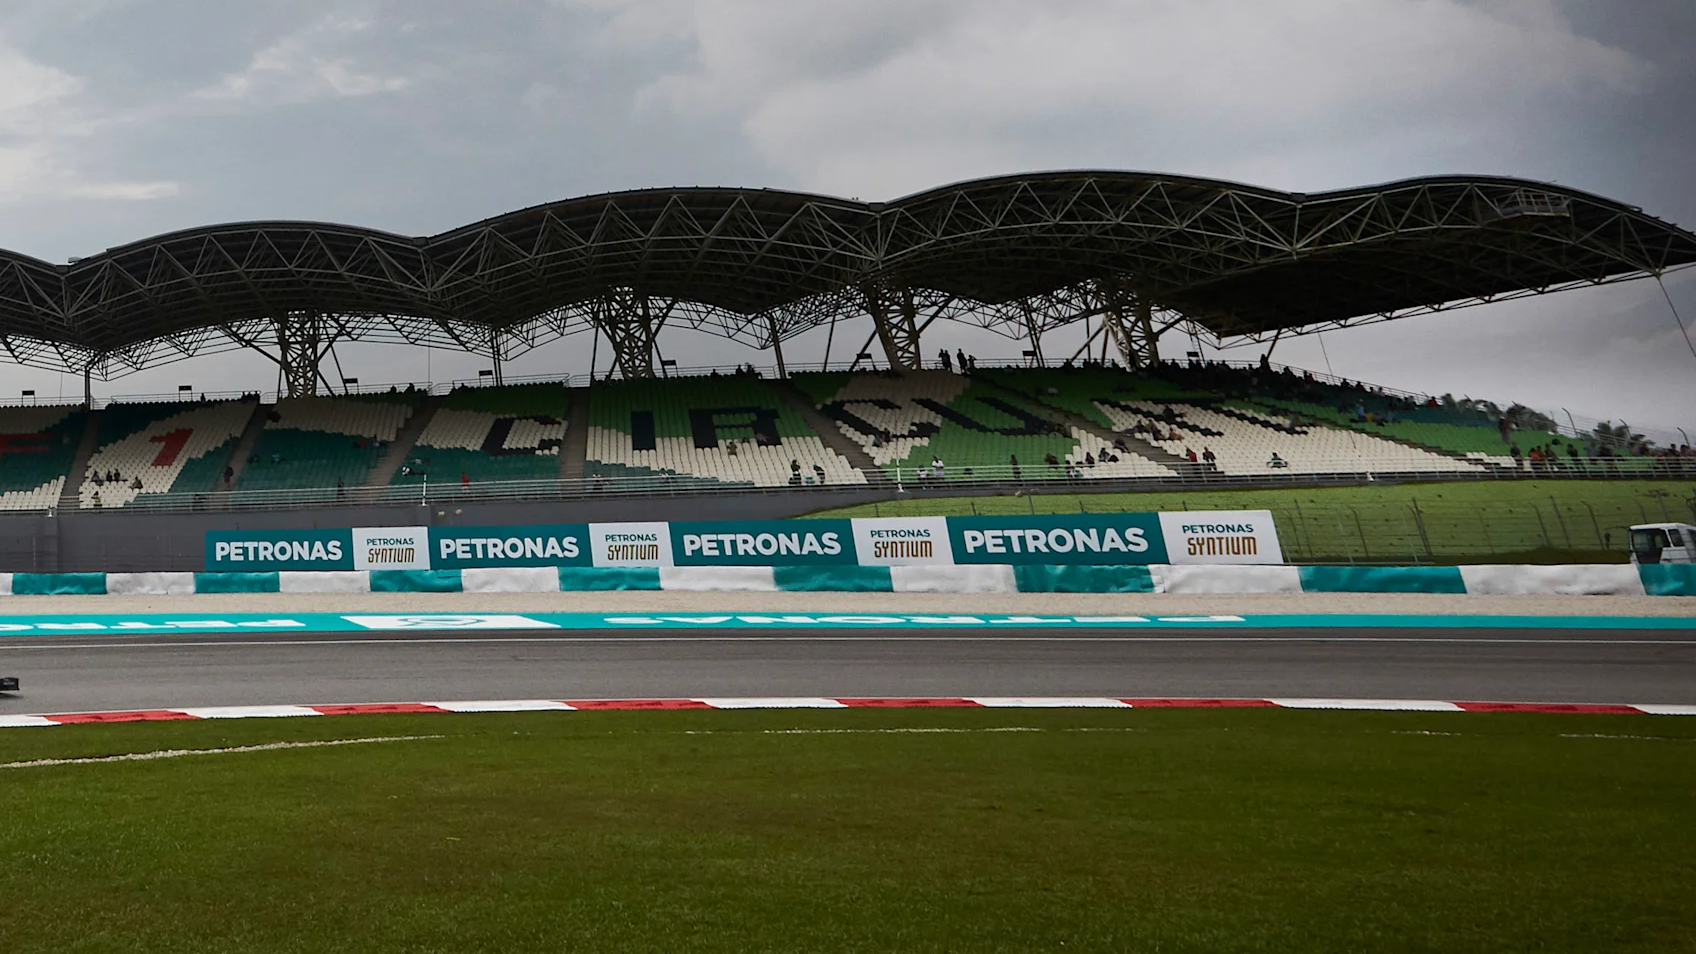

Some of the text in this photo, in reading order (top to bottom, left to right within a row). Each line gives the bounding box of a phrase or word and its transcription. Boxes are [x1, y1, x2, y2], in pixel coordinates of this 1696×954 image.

[605, 533, 658, 542] PETRONAS
[870, 529, 931, 538] PETRONAS
[1182, 524, 1254, 534] PETRONAS
[366, 538, 414, 546] PETRONAS
[440, 536, 580, 559] PETRONAS
[682, 531, 842, 557] PETRONAS
[874, 540, 933, 558] SYNTIUM
[963, 527, 1149, 554] PETRONAS
[1187, 536, 1258, 556] SYNTIUM
[215, 539, 343, 562] PETRONAS
[368, 548, 415, 563] SYNTIUM
[607, 544, 659, 561] SYNTIUM
